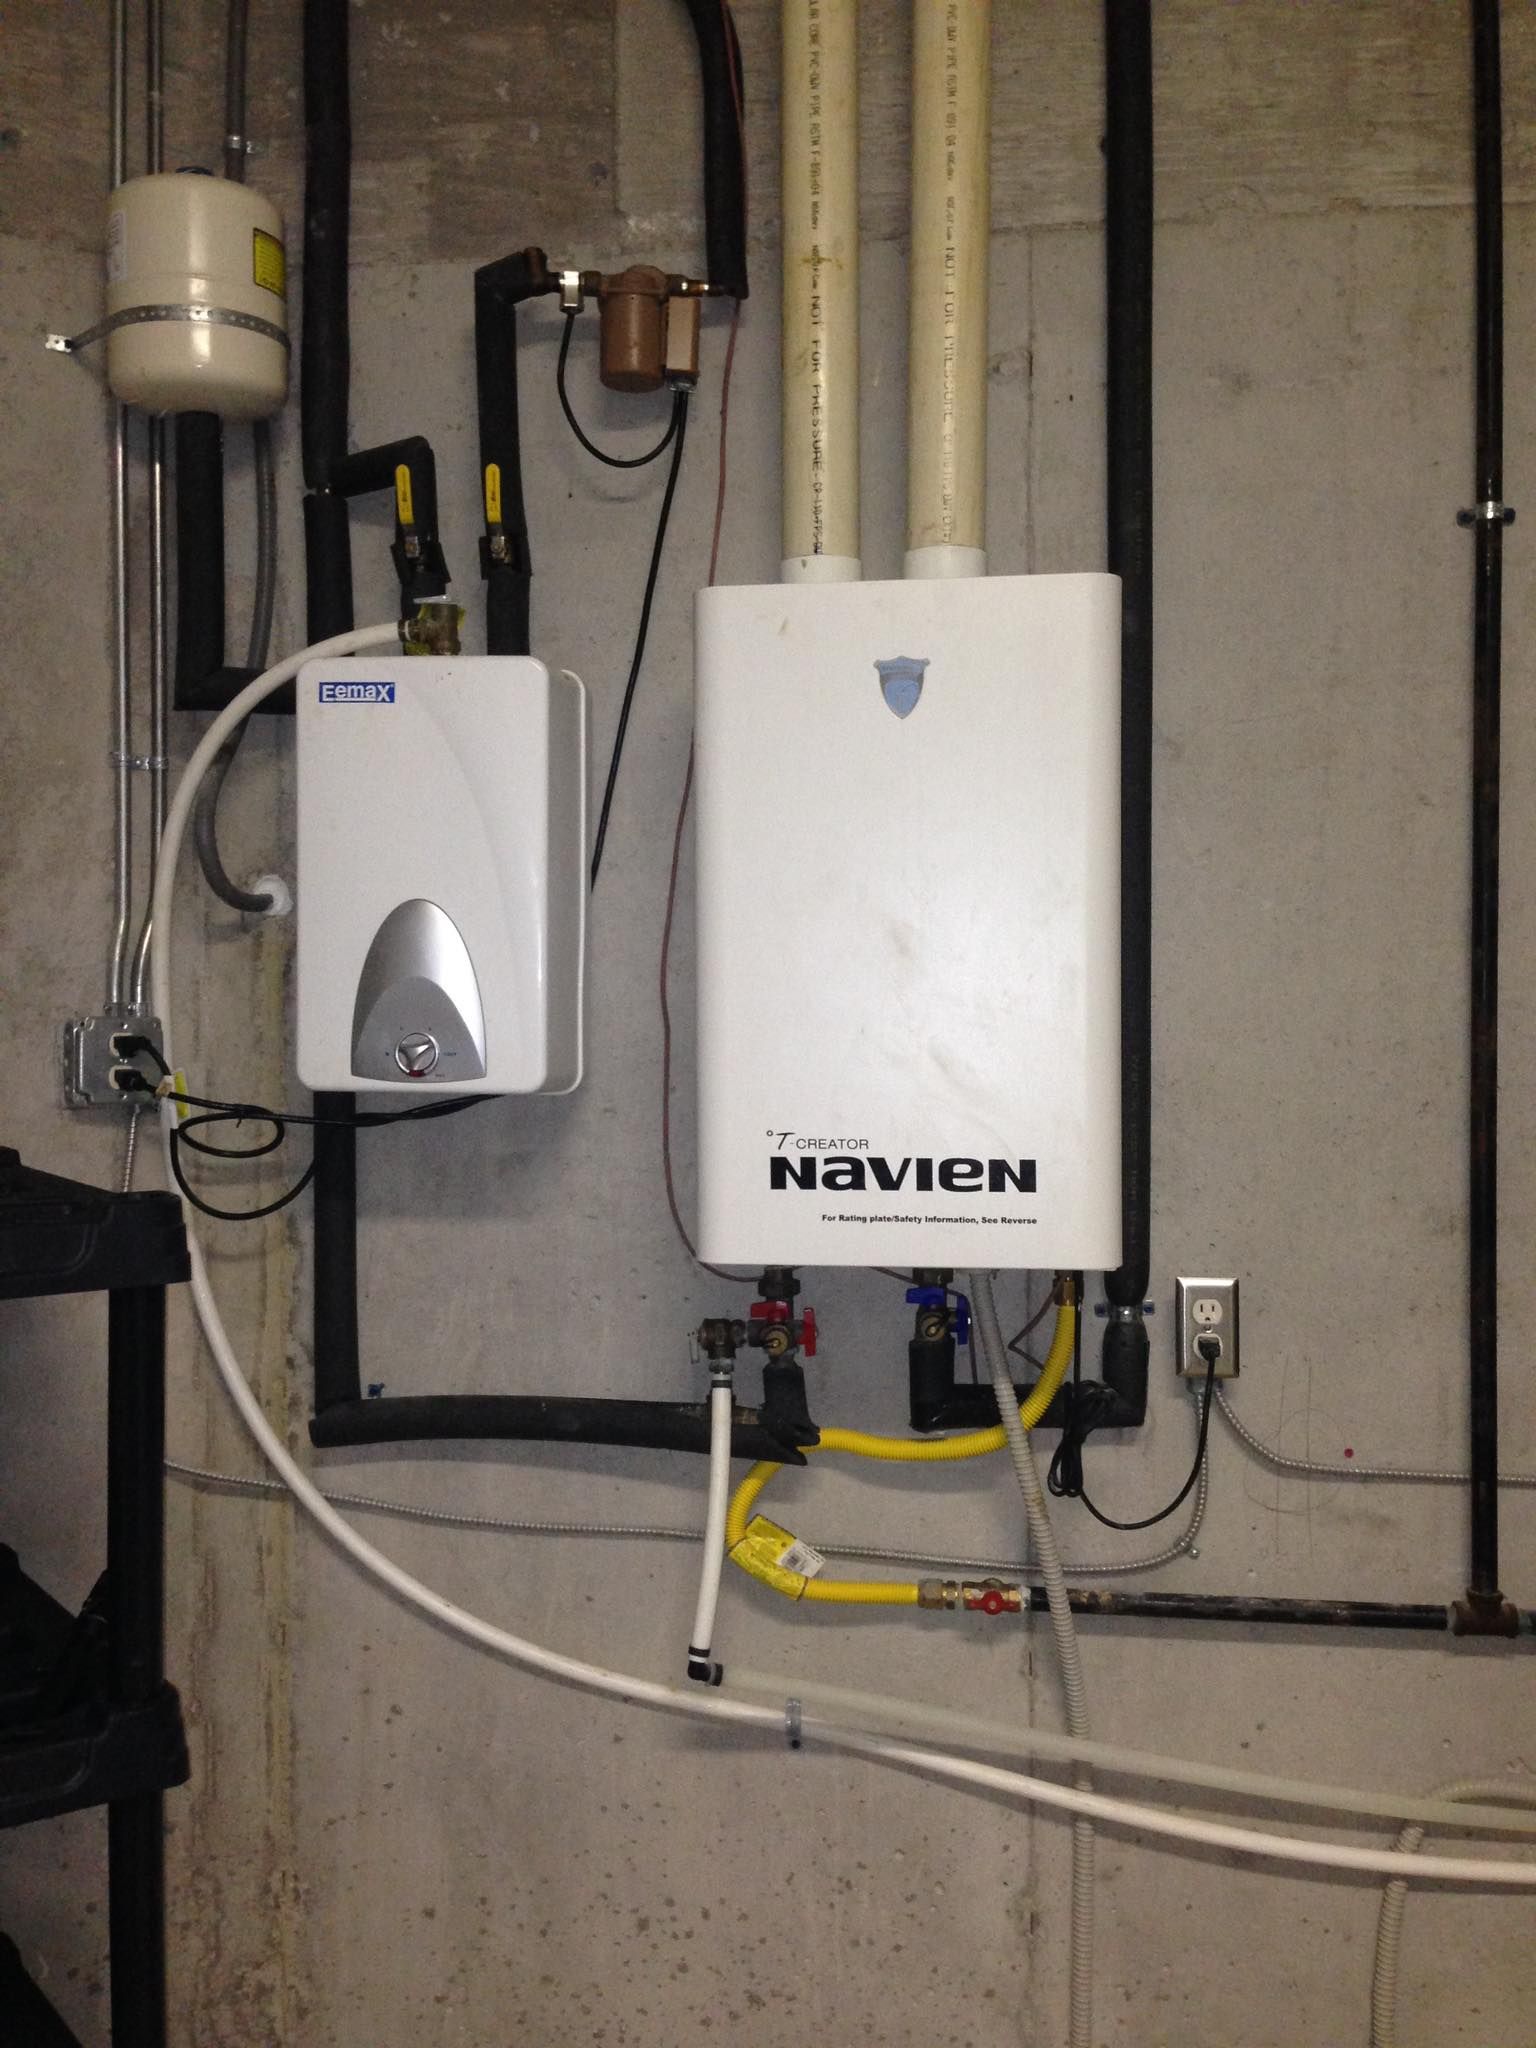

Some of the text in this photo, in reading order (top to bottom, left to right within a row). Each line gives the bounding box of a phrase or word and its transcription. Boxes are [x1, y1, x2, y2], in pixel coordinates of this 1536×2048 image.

[811, 295, 824, 325] NOT
[811, 338, 822, 374] FOR
[822, 1214, 1037, 1225] For Rating plate/Safety Information, See Reverse
